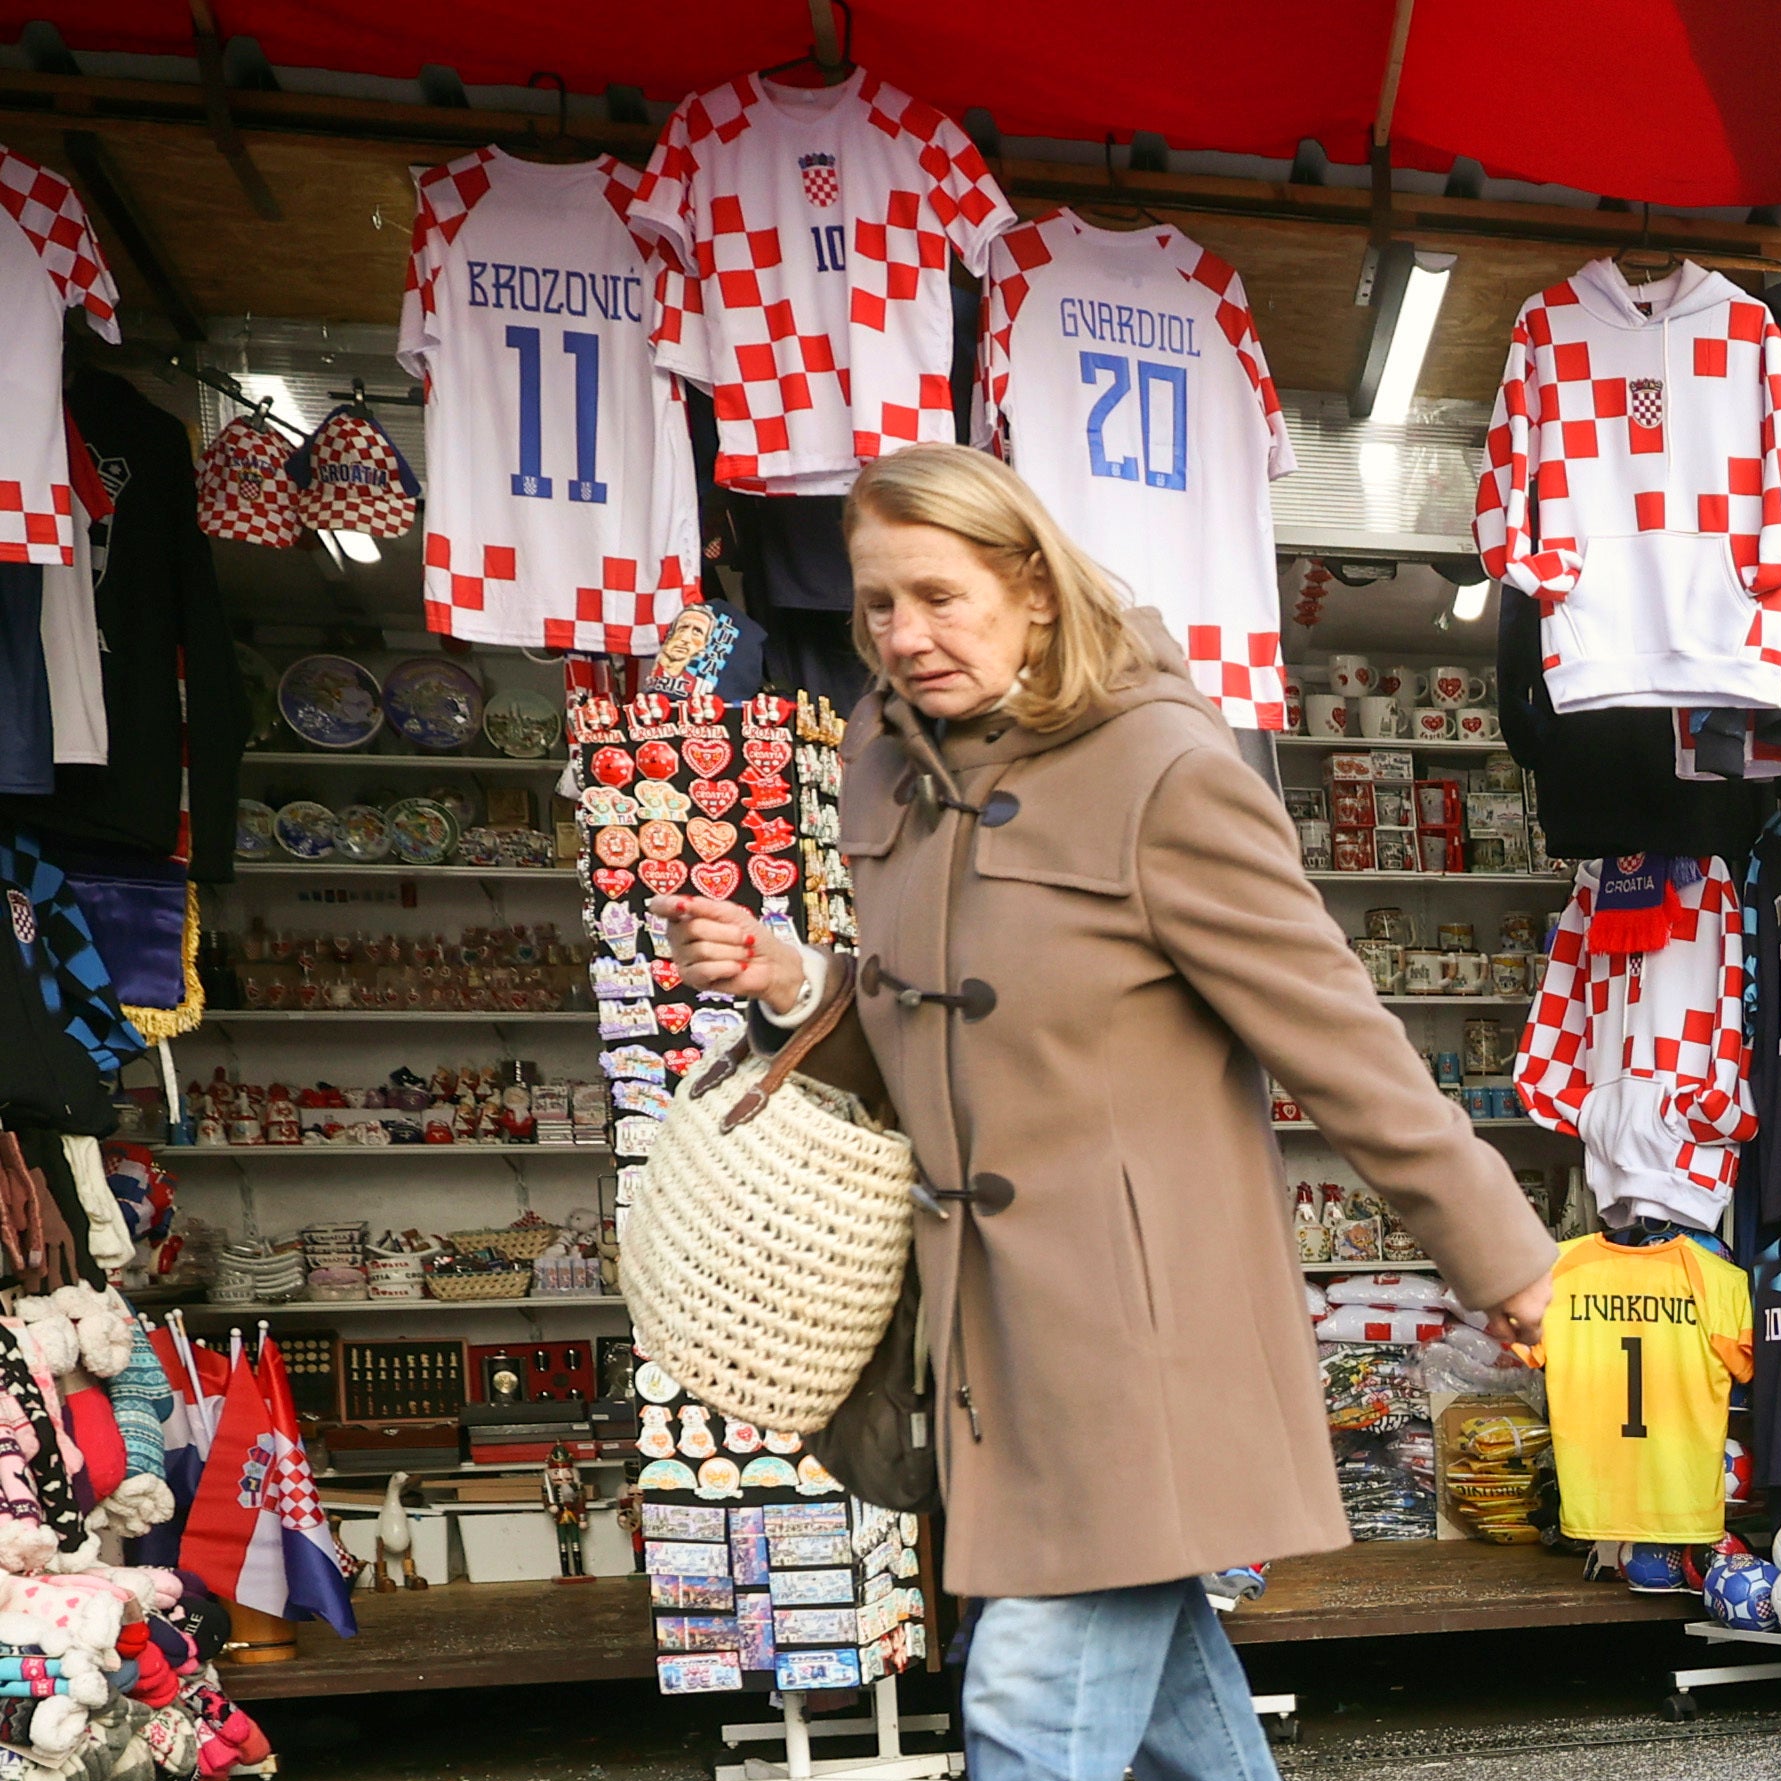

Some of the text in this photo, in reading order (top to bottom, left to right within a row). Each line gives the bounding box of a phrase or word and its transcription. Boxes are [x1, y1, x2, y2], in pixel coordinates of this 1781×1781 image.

[810, 225, 846, 273] 10
[468, 260, 642, 323] BROZOVIĆ
[1060, 297, 1202, 358] GVARDIOL
[505, 325, 608, 505] 11
[1079, 351, 1188, 493] 20
[319, 463, 388, 487] CROATIA
[1604, 875, 1655, 895] CROATIA
[1570, 1294, 1697, 1326] LIVAKOVIĆ
[1620, 1336, 1648, 1438] 1
